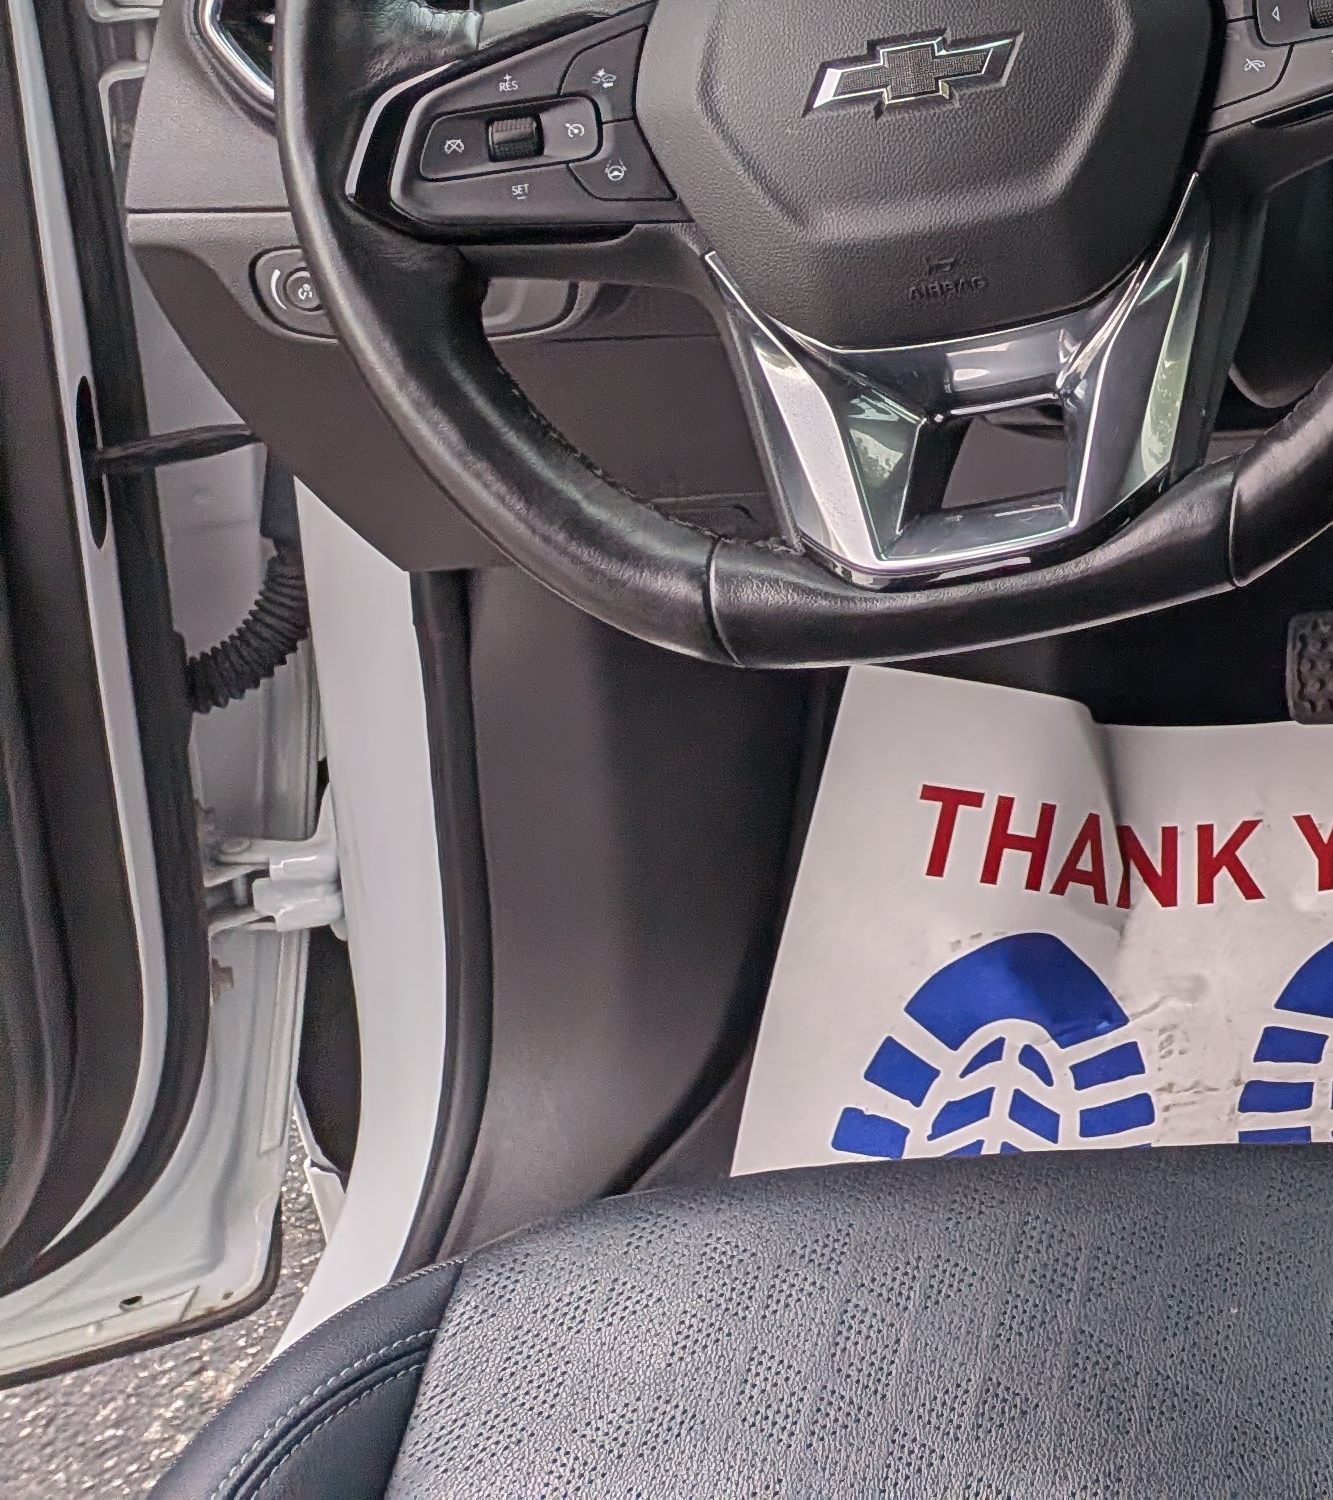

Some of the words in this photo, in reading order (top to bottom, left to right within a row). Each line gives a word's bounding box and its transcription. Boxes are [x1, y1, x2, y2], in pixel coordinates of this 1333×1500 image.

[499, 80, 519, 92] RES
[511, 183, 530, 196] SET
[909, 276, 987, 301] AIRBAG
[918, 783, 1266, 909] THANK
